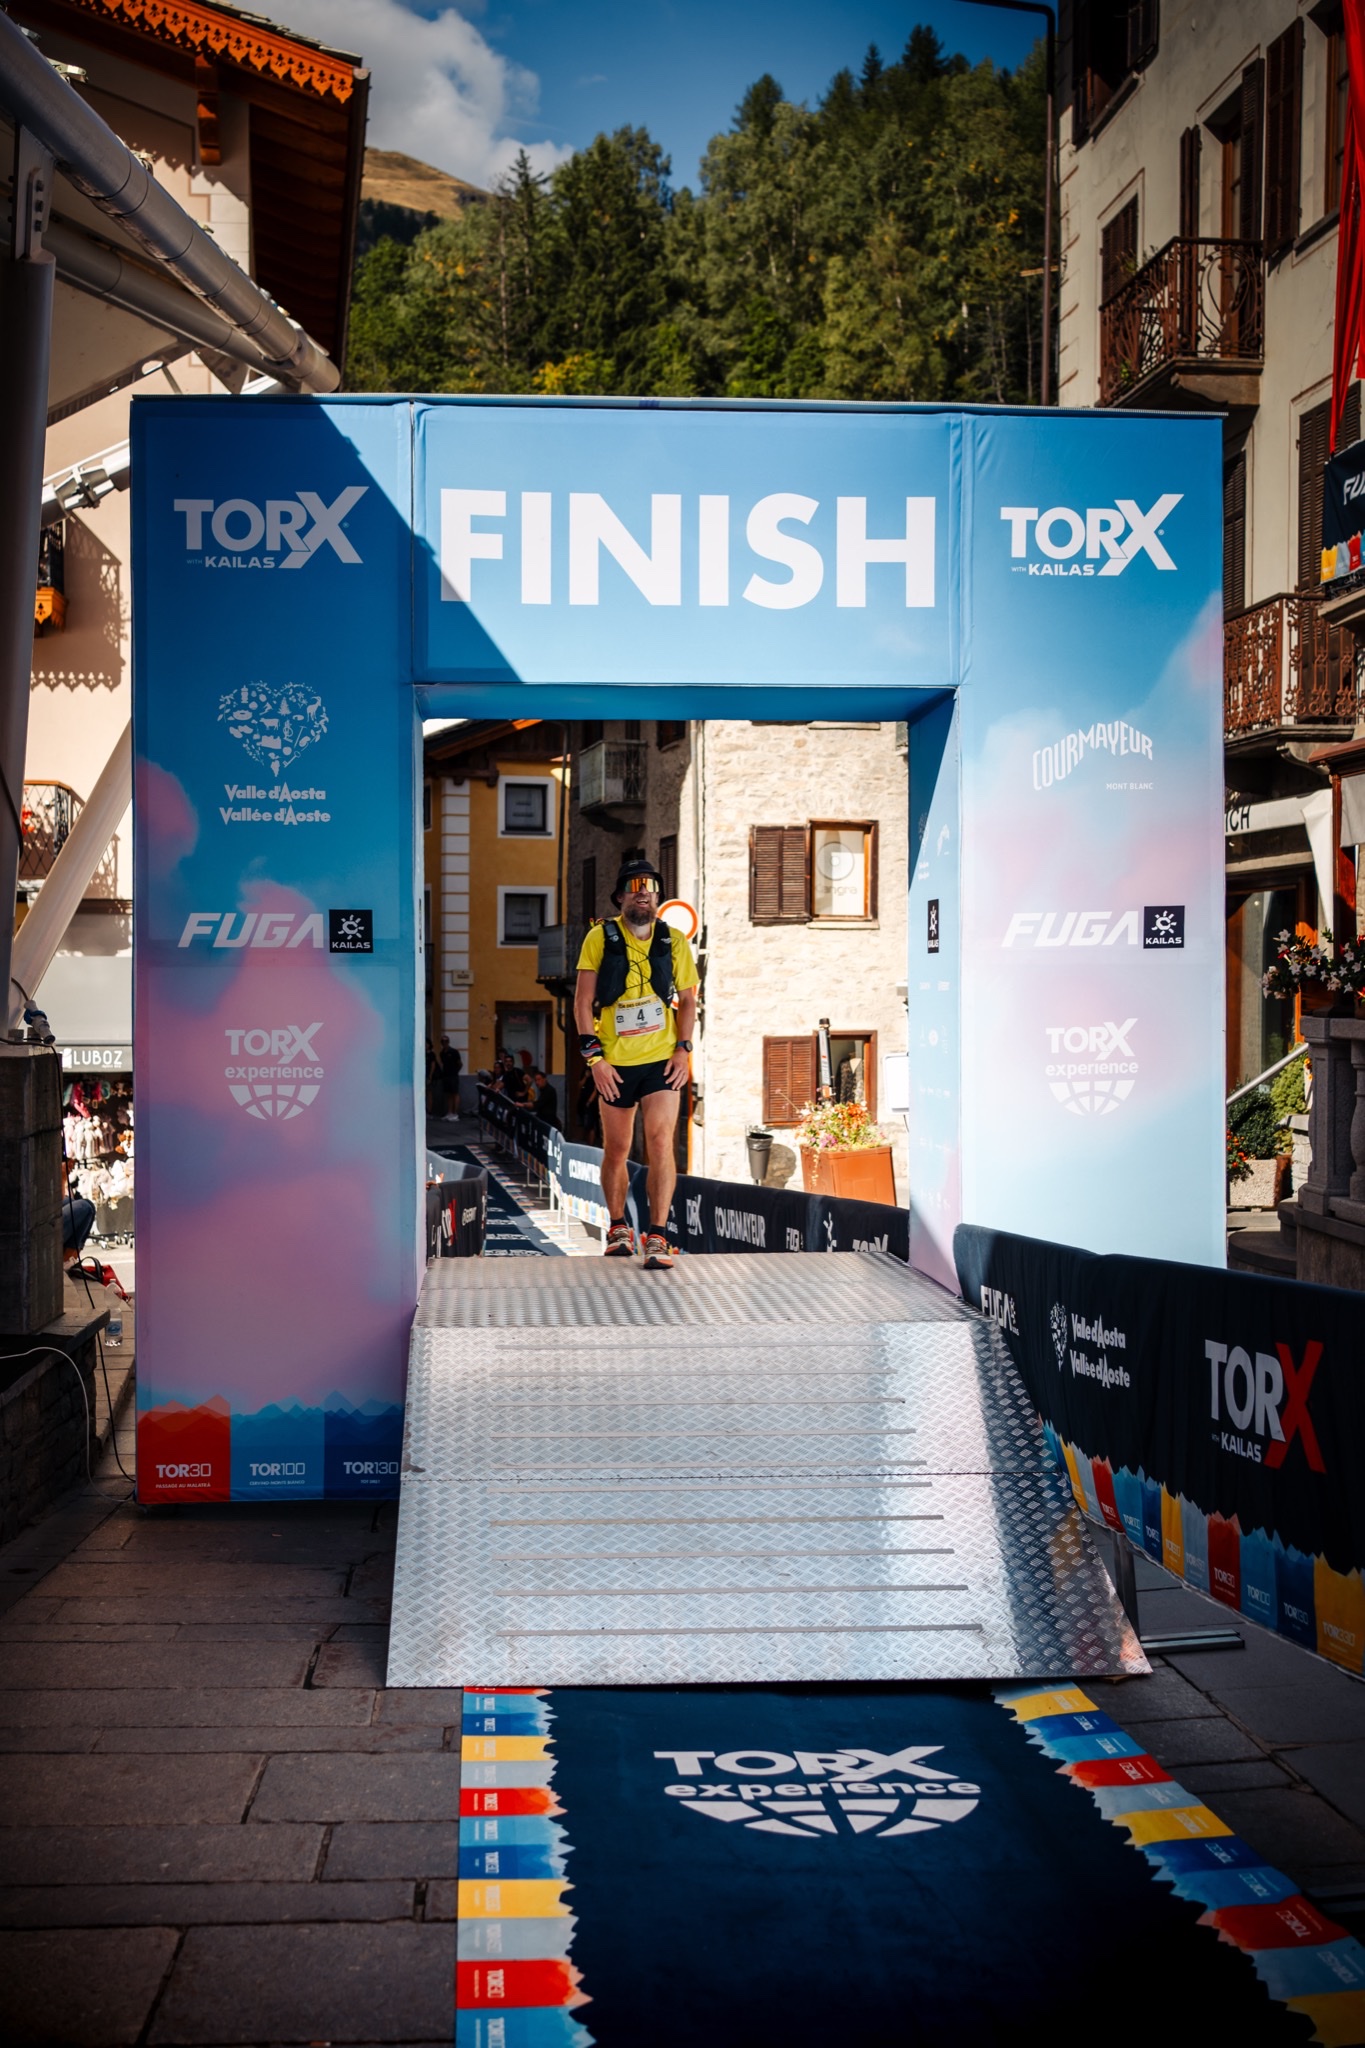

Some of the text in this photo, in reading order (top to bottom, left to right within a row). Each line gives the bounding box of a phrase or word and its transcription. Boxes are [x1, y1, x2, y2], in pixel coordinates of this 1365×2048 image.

[174, 486, 370, 569] TORX
[1000, 494, 1185, 576] TORX
[441, 488, 936, 609] FINISH
[205, 556, 275, 568] KAILAS
[1028, 563, 1095, 576] KAILAS
[1033, 720, 1153, 791] COURMAYEUR
[224, 781, 326, 802] Valle d'Aosta
[1106, 782, 1153, 790] MONT BLANC
[219, 804, 331, 826] Vallée d'Aoste
[178, 912, 324, 948] FUGA
[1001, 910, 1139, 948] FUGA
[332, 941, 371, 949] KAILAS
[1145, 936, 1182, 945] KAILAS
[637, 1008, 645, 1021] 4
[224, 1022, 325, 1065] TORX
[1045, 1018, 1139, 1061] TORX
[73, 1050, 123, 1065] LUBOZ
[224, 1066, 325, 1082] experience
[1045, 1062, 1139, 1079] experience
[714, 1205, 766, 1248] COURMAYEUR
[1071, 1313, 1091, 1342] Valle
[1204, 1338, 1327, 1474] TORX
[1221, 1431, 1262, 1463] KAILAS
[155, 1463, 212, 1478] TOR30
[249, 1462, 306, 1476] TOR100
[343, 1461, 399, 1475] TOR130
[1213, 1567, 1235, 1588] TOR30
[1246, 1583, 1271, 1606] TOR100
[653, 1745, 960, 1783] TORX
[664, 1782, 982, 1800] experience
